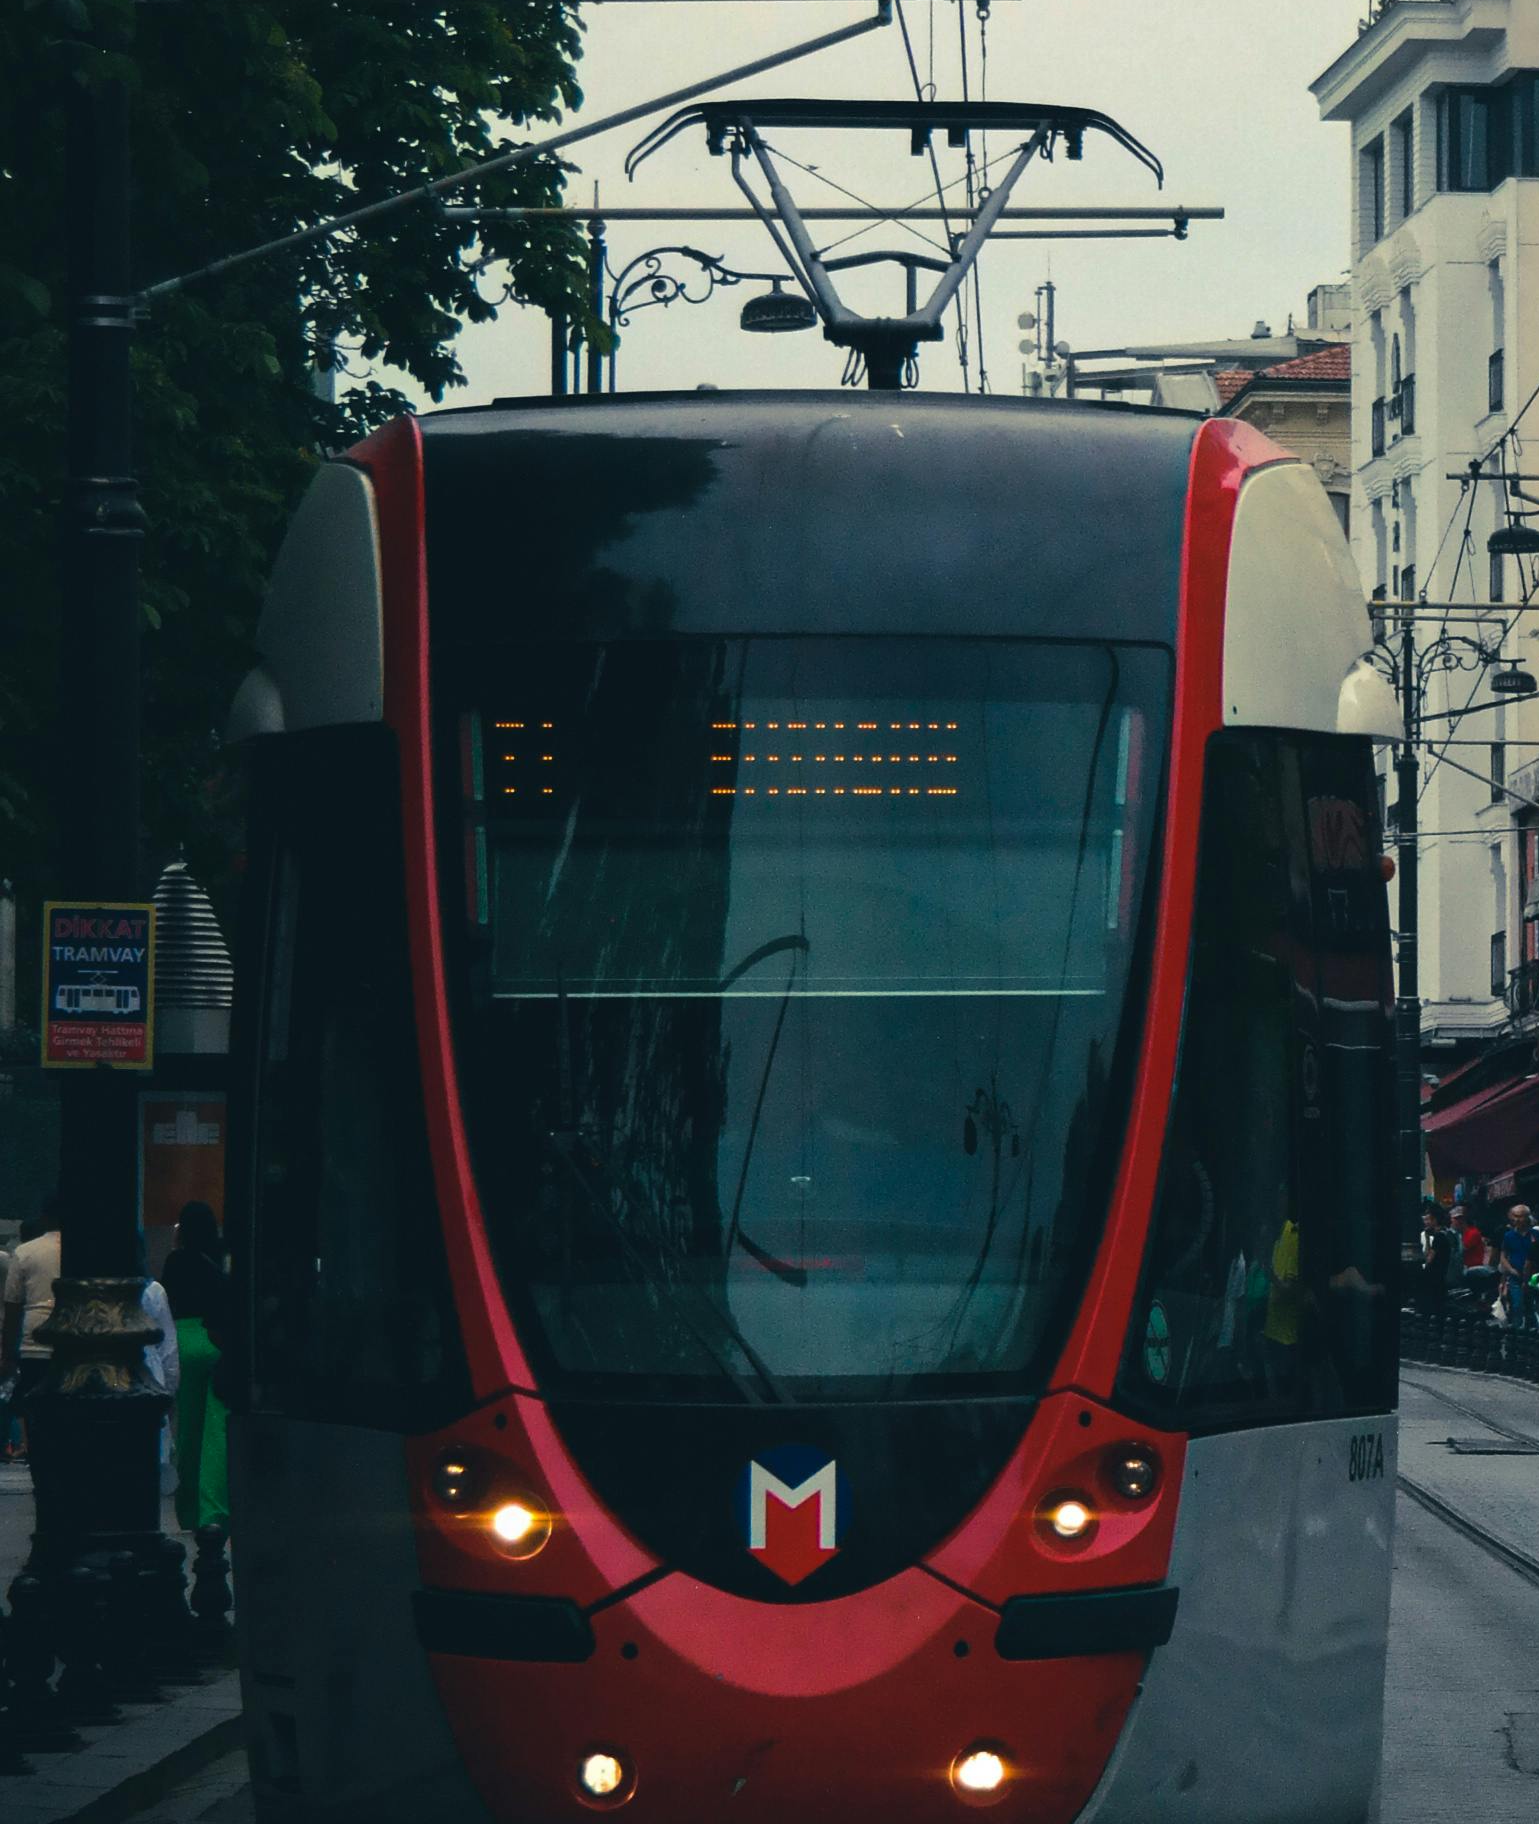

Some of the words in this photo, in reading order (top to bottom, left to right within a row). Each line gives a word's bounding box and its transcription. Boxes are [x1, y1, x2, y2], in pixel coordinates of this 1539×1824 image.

[54, 915, 146, 939] DİKKAT
[52, 945, 146, 964] TRAMVAY
[52, 1025, 97, 1037] Tramvay
[53, 1036, 93, 1048] Girmek
[96, 1036, 143, 1048] Tehlikeli
[67, 1049, 81, 1058] ve
[1348, 1432, 1384, 1482] 807A
[750, 1459, 836, 1550] M
